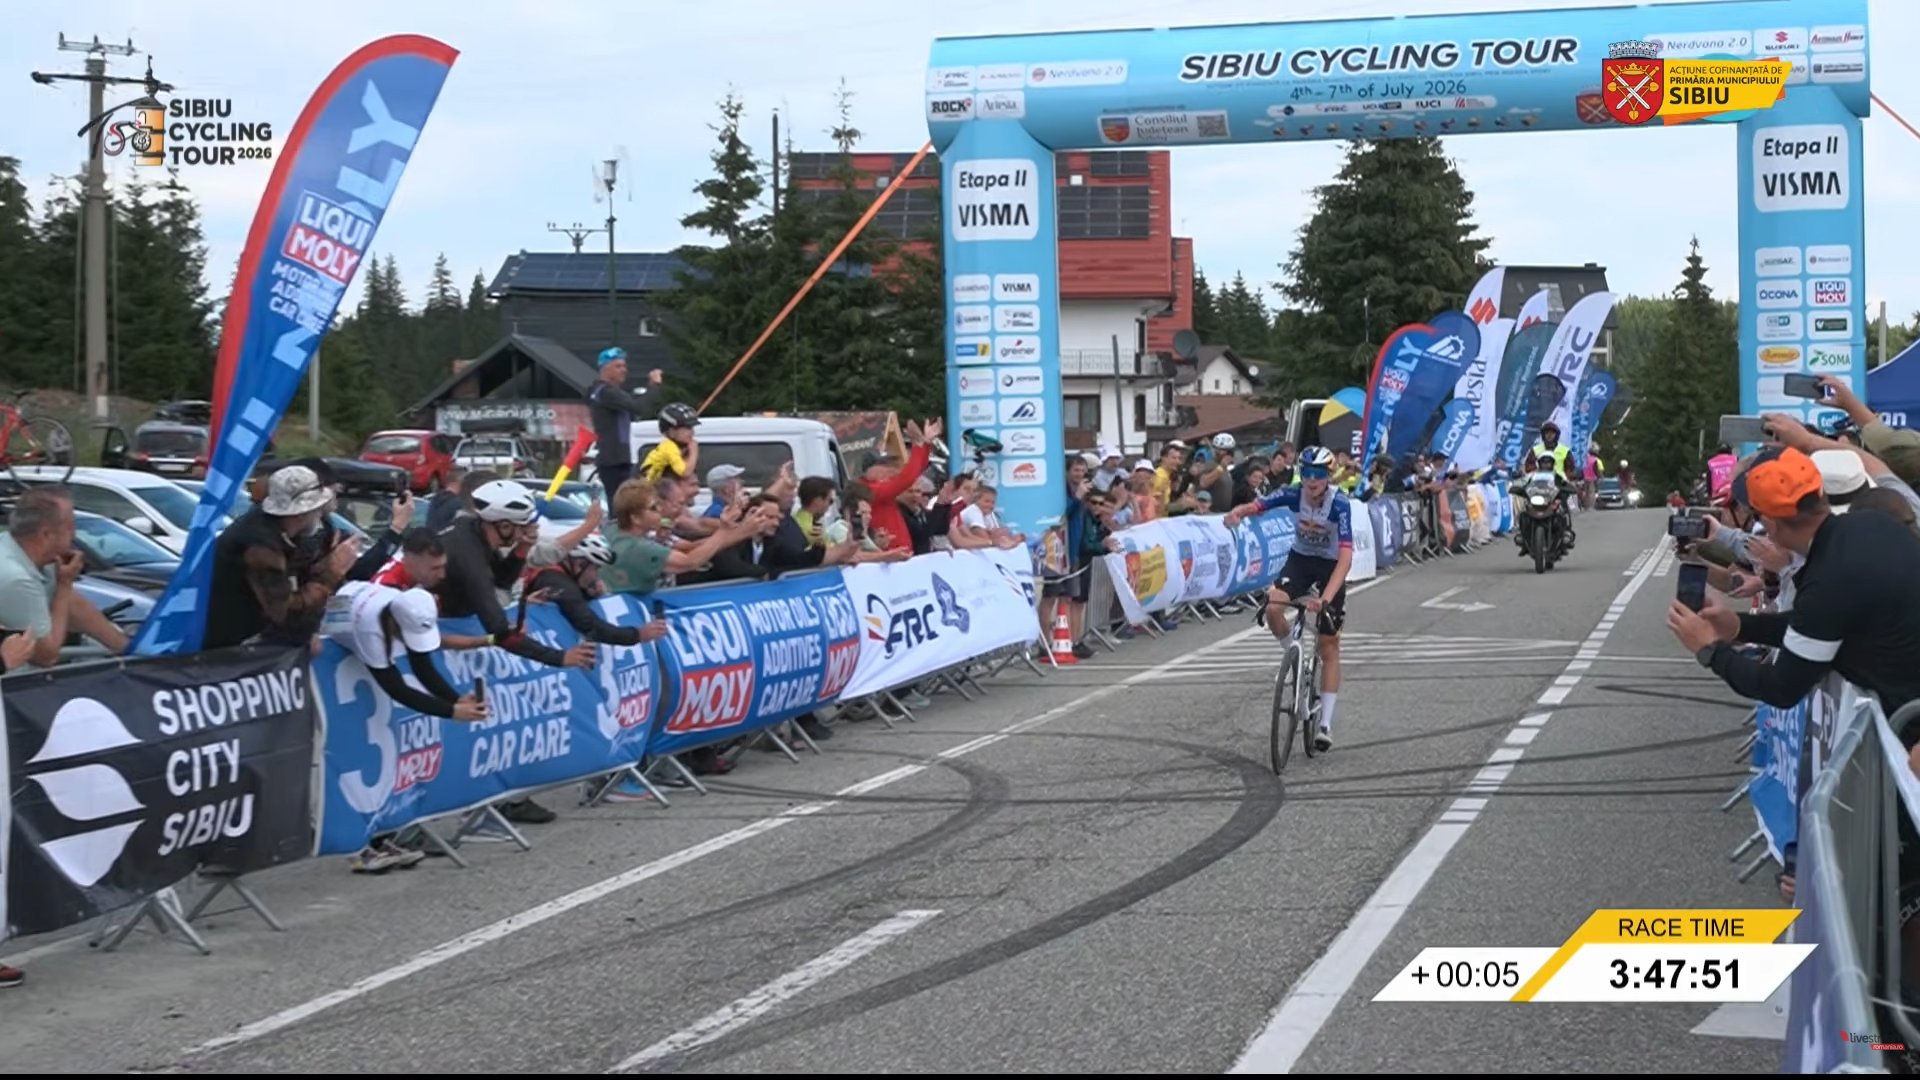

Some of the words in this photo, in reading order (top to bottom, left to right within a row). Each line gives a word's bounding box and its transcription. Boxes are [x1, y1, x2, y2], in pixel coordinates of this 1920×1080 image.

[1181, 53, 1281, 79] SIBIU
[1290, 43, 1459, 75] CYCLING
[1471, 38, 1578, 67] TOUR
[1358, 84, 1375, 98] of
[1381, 82, 1414, 98] July
[1425, 79, 1467, 96] 2026
[1135, 114, 1188, 127] Consiliul
[1763, 138, 1821, 159] Etapa
[1826, 136, 1839, 154] II
[959, 171, 1009, 191] Etapa
[1015, 169, 1027, 187] II
[1762, 171, 1842, 197] VISMA
[300, 196, 373, 250] LIQUI
[958, 203, 1030, 227] VISMA
[289, 228, 359, 281] MOLY
[1816, 282, 1845, 292] LIQUI
[1816, 293, 1845, 303] MOLY
[1822, 354, 1850, 366] SOMA
[741, 599, 794, 636] MOTOR
[793, 594, 821, 631] OILS
[884, 603, 940, 660] FRC
[665, 609, 750, 667] LIQUI
[762, 633, 823, 678] ADDITIVES
[618, 663, 650, 696] LIQUI
[674, 667, 753, 727] MOLY
[757, 680, 790, 718] CAR
[784, 669, 821, 709] CARE
[153, 667, 305, 736] SHOPPING
[617, 692, 651, 728] MOLY
[401, 716, 441, 752] LIQUI
[469, 732, 517, 781] CAR
[518, 716, 572, 767] CARE
[166, 738, 240, 797] CITY
[397, 748, 442, 789] MOLY
[158, 794, 255, 857] SIBIU
